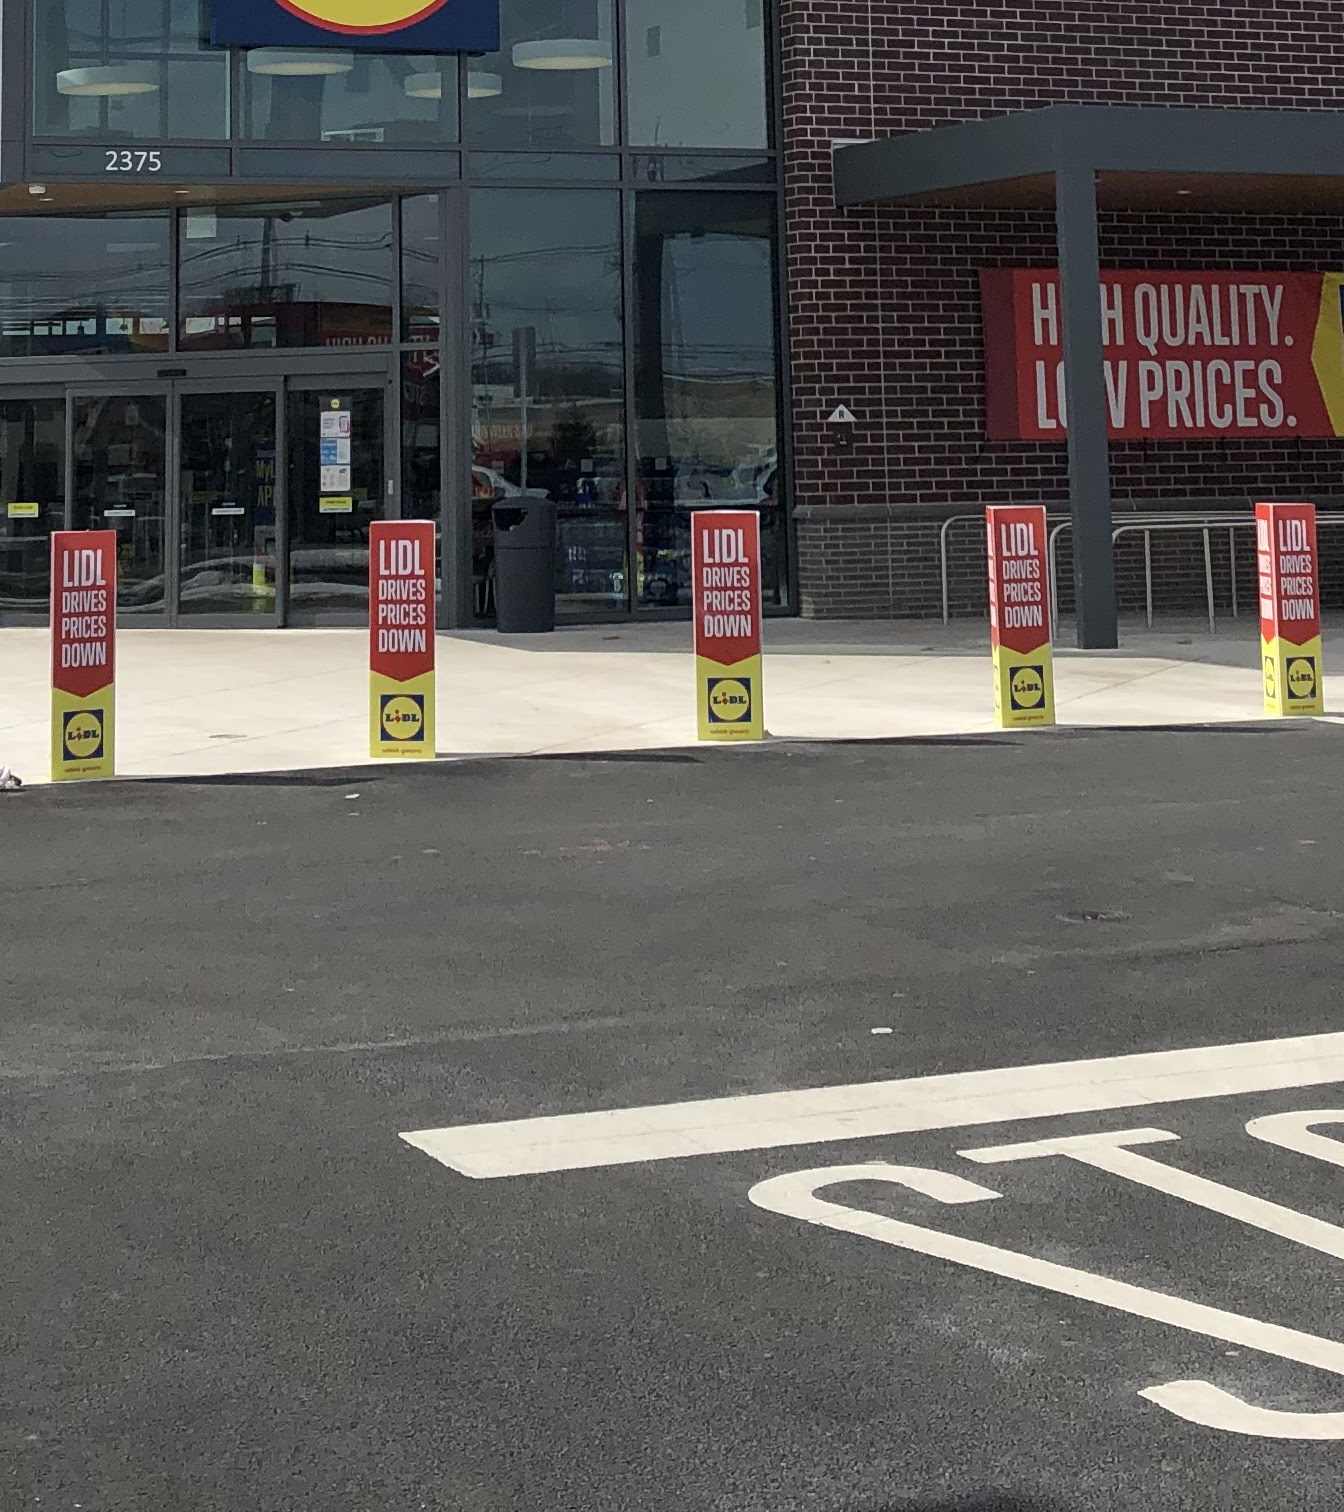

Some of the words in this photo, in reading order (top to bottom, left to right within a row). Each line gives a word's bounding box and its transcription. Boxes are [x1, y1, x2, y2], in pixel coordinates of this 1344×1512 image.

[105, 151, 162, 172] 2375
[1032, 283, 1125, 346] HH
[1134, 283, 1295, 357] QUALITY.
[1138, 359, 1298, 429] PRICES.
[703, 528, 748, 564] LIDL
[1000, 523, 1038, 557] LIDL
[1278, 520, 1311, 552] LIDL
[63, 549, 106, 587] LIDL
[379, 540, 424, 576] LIDL
[1002, 559, 1040, 580] DRIVES
[1280, 555, 1312, 574] DRIVES
[703, 566, 750, 588] DRIVES
[1280, 576, 1313, 596] PRICES
[62, 590, 106, 613] DRIVES
[379, 579, 425, 601] DRIVES
[703, 590, 751, 611] PRICES
[1003, 582, 1041, 603] PRICES
[379, 604, 425, 626] PRICES
[1005, 604, 1042, 628] DOWN
[1282, 599, 1314, 621] DOWN
[62, 616, 106, 639] PRICES
[704, 614, 752, 638] DOWN
[379, 629, 426, 653] DOWN
[62, 642, 106, 668] DOWN
